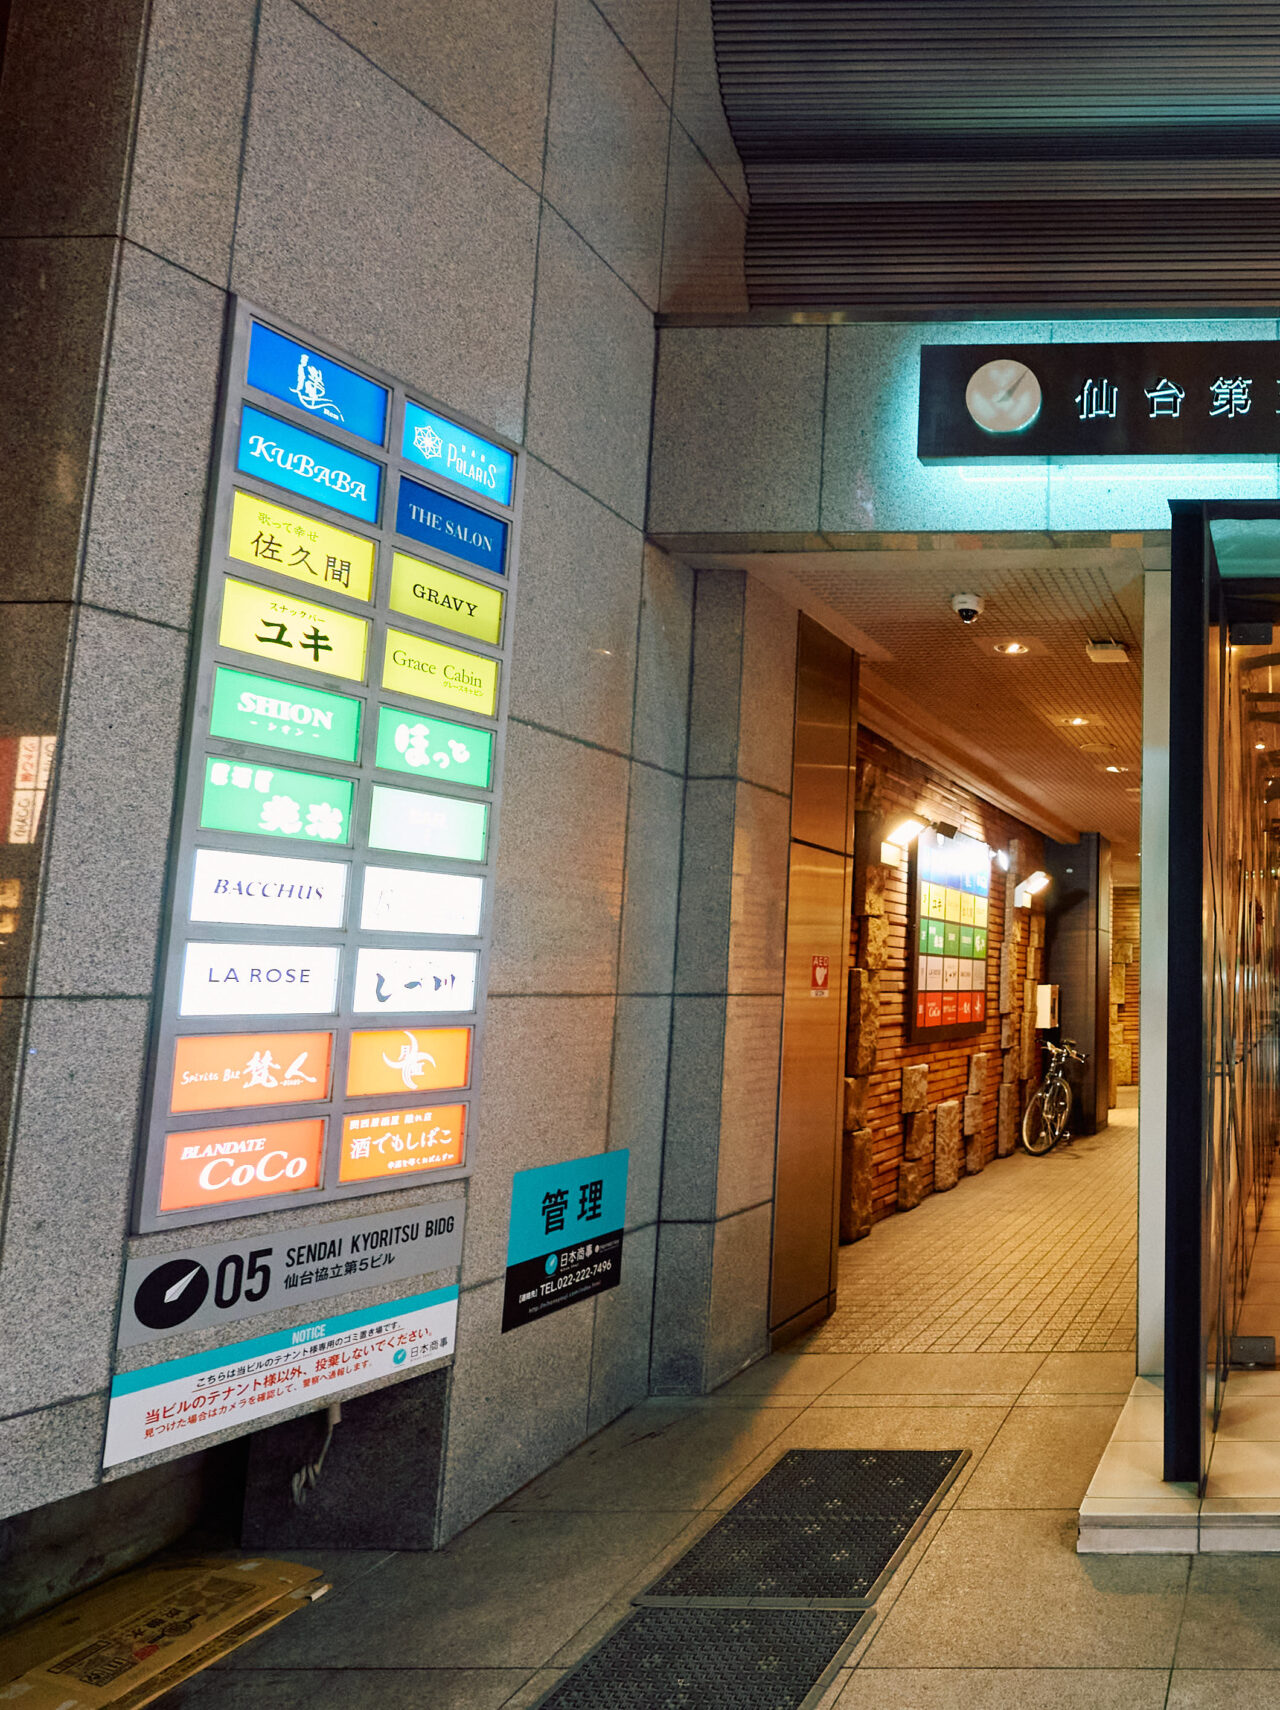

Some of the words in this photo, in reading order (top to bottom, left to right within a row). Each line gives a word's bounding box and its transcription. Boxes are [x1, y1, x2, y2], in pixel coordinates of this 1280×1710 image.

[249, 435, 367, 501] KUBABA
[257, 511, 319, 543] 歌って幸せ
[409, 503, 443, 532] THE
[445, 514, 493, 552] SALON
[250, 530, 351, 589] 佐久間
[270, 602, 326, 624] スナックバー
[412, 583, 478, 618] GRAVY
[255, 618, 333, 662] ユキ
[392, 649, 437, 675] Grace
[443, 664, 482, 688] Cabin
[237, 691, 334, 731] SHION
[213, 878, 325, 901] BACCHUS
[208, 967, 240, 984] LA
[250, 968, 312, 984] ROSE
[180, 1137, 267, 1161] BLANDATE
[350, 1127, 453, 1160] 酒でもしばこ
[199, 1150, 308, 1191] CoCo
[541, 1179, 603, 1236] 管理
[286, 1238, 342, 1268] SENDAI
[351, 1224, 419, 1254] KYORITSU
[214, 1247, 273, 1309] 05
[284, 1253, 396, 1290] 仙台協立第5ビル
[292, 1324, 326, 1346] NOTICE
